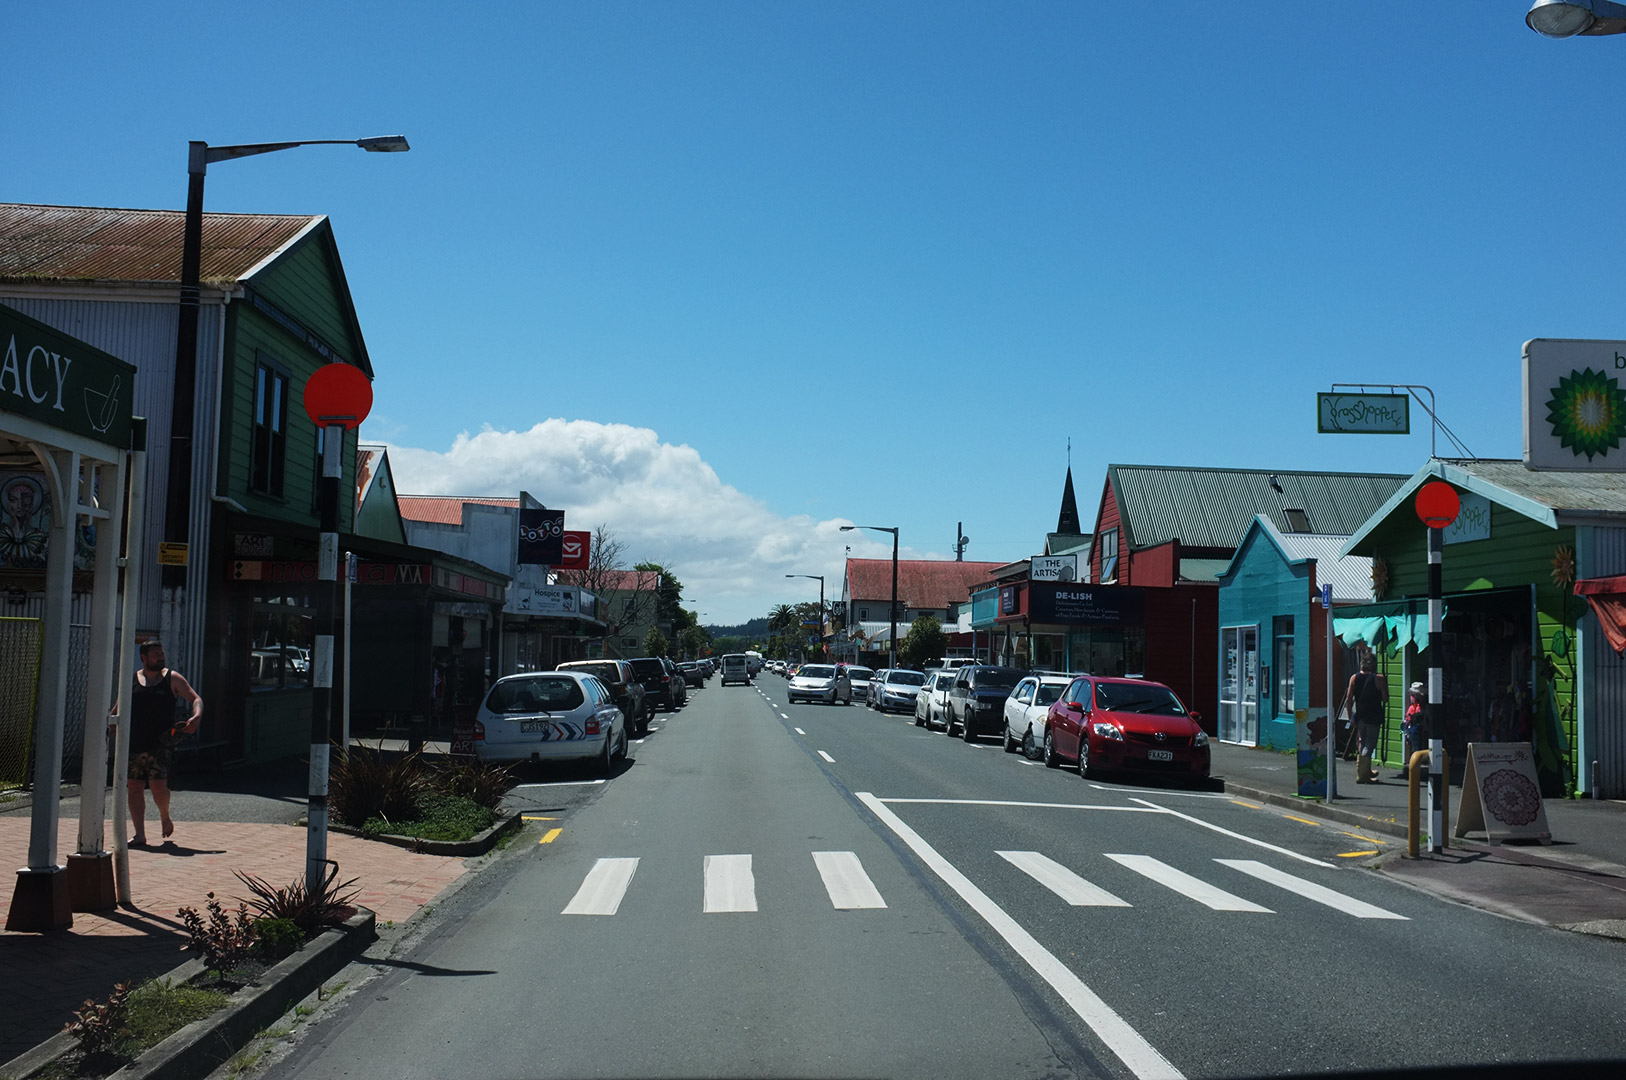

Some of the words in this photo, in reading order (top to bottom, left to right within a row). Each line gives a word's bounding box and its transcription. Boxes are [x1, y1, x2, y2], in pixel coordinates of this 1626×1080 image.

[0, 333, 72, 412] ACY
[519, 521, 561, 541] LOTTO
[241, 536, 264, 546] ART
[534, 589, 560, 598] Hospice
[1056, 592, 1093, 600] DE-LISH
